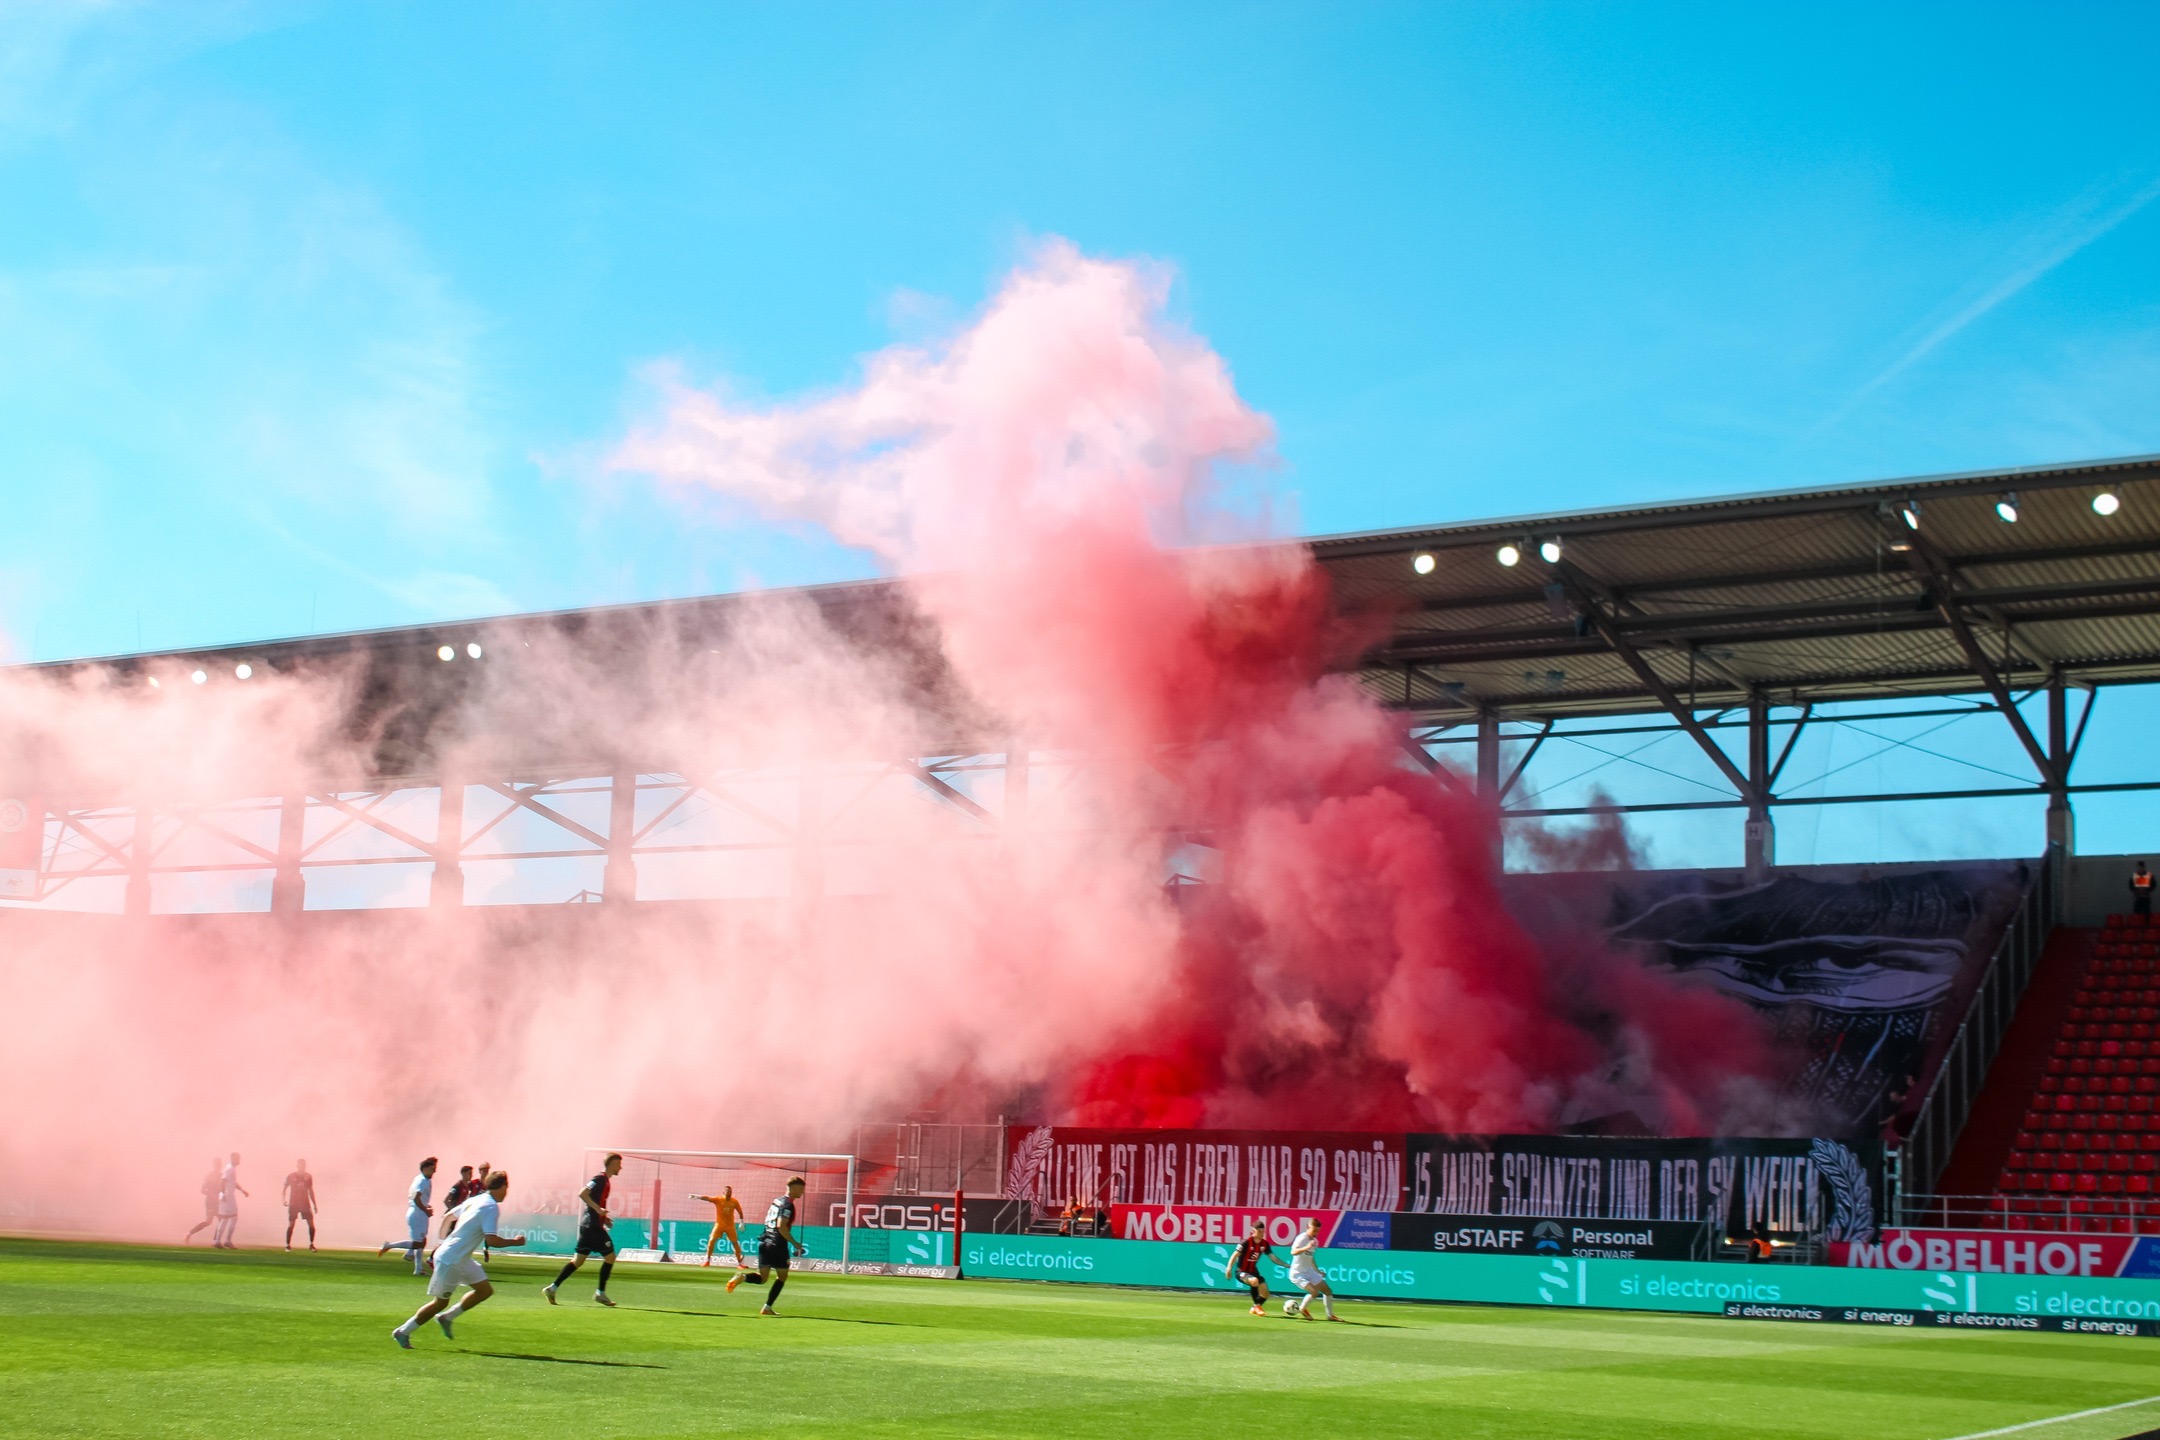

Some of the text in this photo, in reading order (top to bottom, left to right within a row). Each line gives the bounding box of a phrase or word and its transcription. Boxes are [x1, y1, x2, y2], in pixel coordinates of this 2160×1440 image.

[1109, 1143, 1138, 1206] IST
[1144, 1143, 1177, 1206] DAS
[1183, 1143, 1239, 1208] LEBEN
[1247, 1145, 1293, 1210] HALB
[1297, 1147, 1327, 1211] SO
[1412, 1152, 1431, 1214] 15
[1433, 1152, 1495, 1216] JAHRE
[1501, 1152, 1601, 1218] SCHANZER
[1608, 1158, 1650, 1220] UND
[1659, 1158, 1699, 1222] DER
[1707, 1156, 1737, 1231] SV
[1744, 1156, 1819, 1232] WEHEN
[1434, 1229, 1524, 1250] guSTAFF
[1572, 1228, 1654, 1246] Personal
[968, 1246, 1094, 1270] si electronics
[1572, 1248, 1636, 1260] SOFTWARE
[1847, 1230, 2103, 1277] MÖBELHOF
[1620, 1275, 1782, 1301] si electronics
[2015, 1290, 2038, 1312] si
[1727, 1305, 1823, 1320] si electronics
[1844, 1309, 1914, 1326] si energy
[1937, 1313, 2039, 1328] si electronics
[2062, 1319, 2138, 1336] si energy
